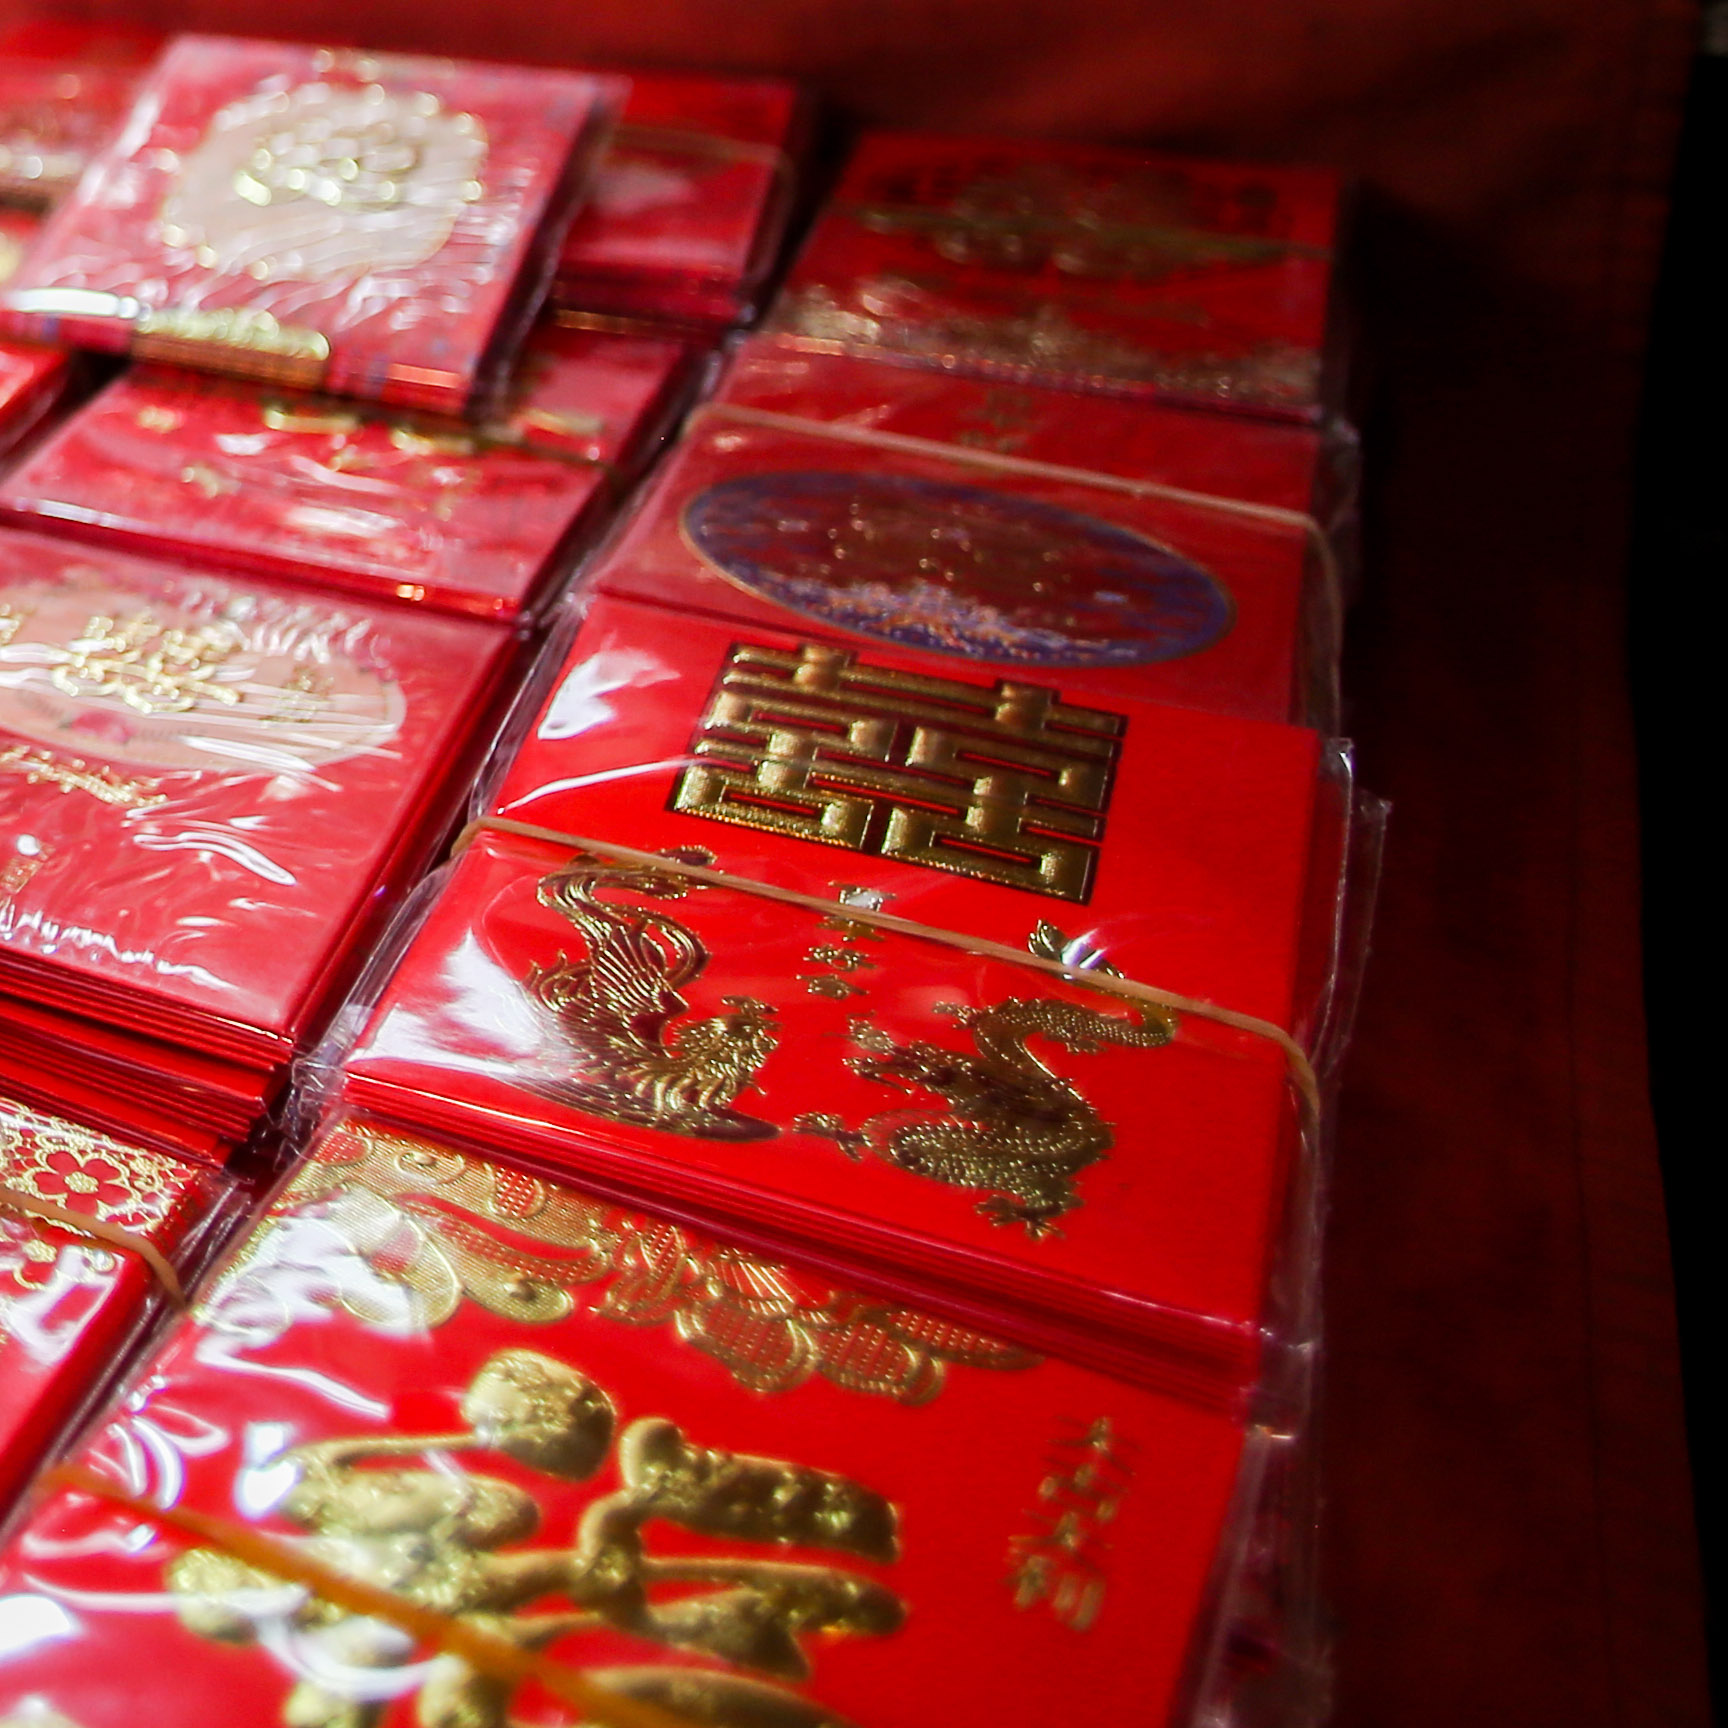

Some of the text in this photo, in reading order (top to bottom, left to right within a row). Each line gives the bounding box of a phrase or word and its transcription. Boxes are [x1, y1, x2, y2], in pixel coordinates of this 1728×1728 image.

[666, 642, 1127, 904] 囍
[1001, 1412, 1136, 1631] 大吉大利
